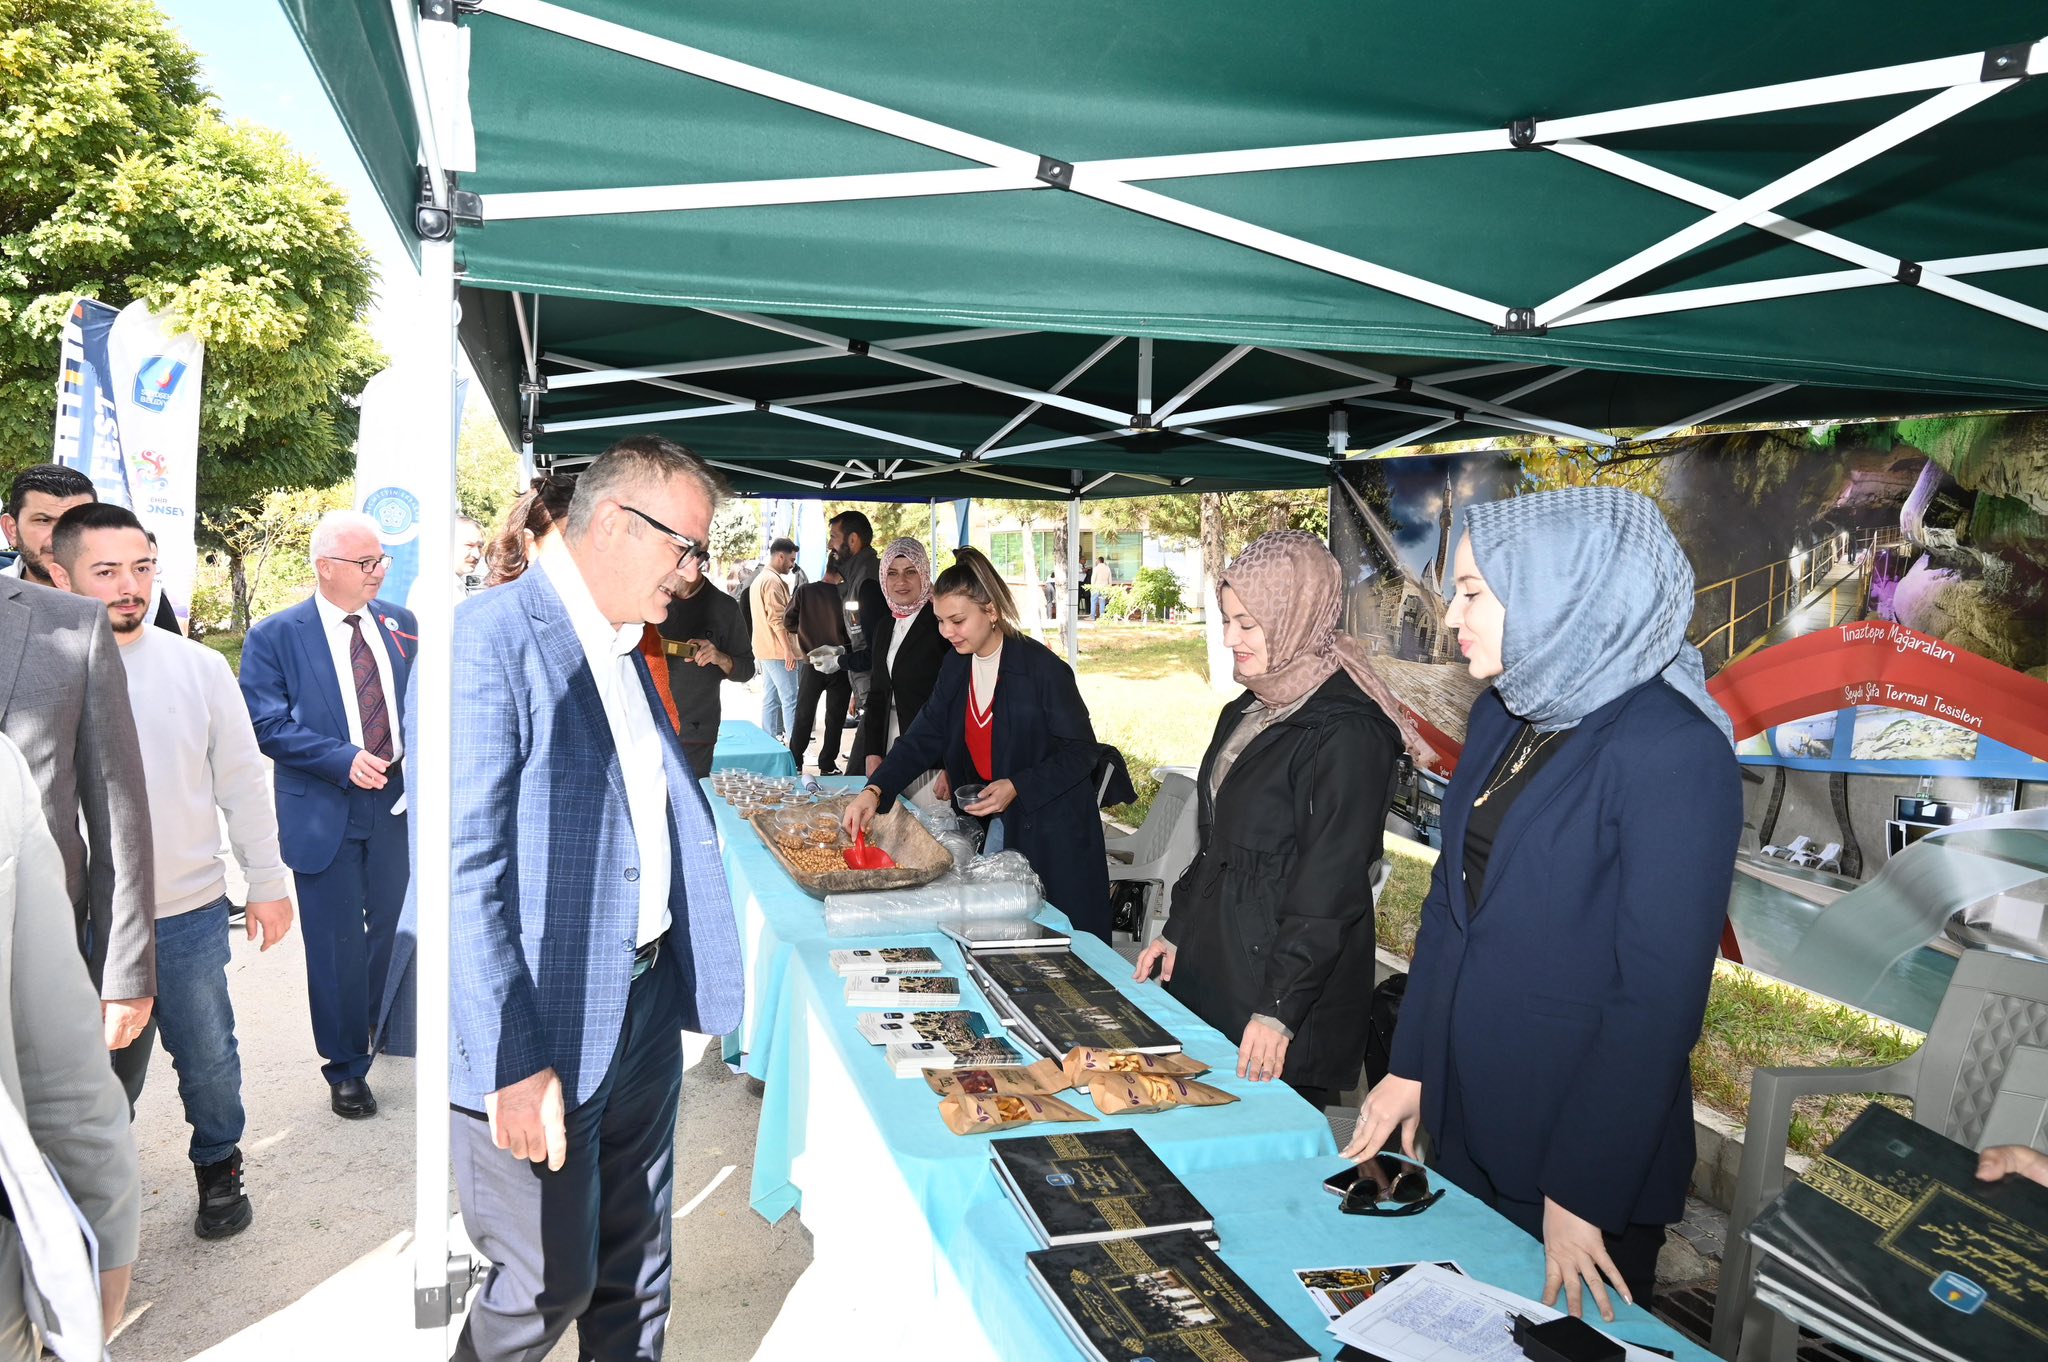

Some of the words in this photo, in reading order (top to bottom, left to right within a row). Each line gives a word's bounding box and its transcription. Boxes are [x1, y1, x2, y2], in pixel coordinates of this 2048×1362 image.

[1839, 622, 1885, 644] Tınaztepe
[1887, 623, 1956, 663] Mağaraları
[1885, 683, 1929, 707] Termal
[1933, 695, 1983, 728] Tesisleri
